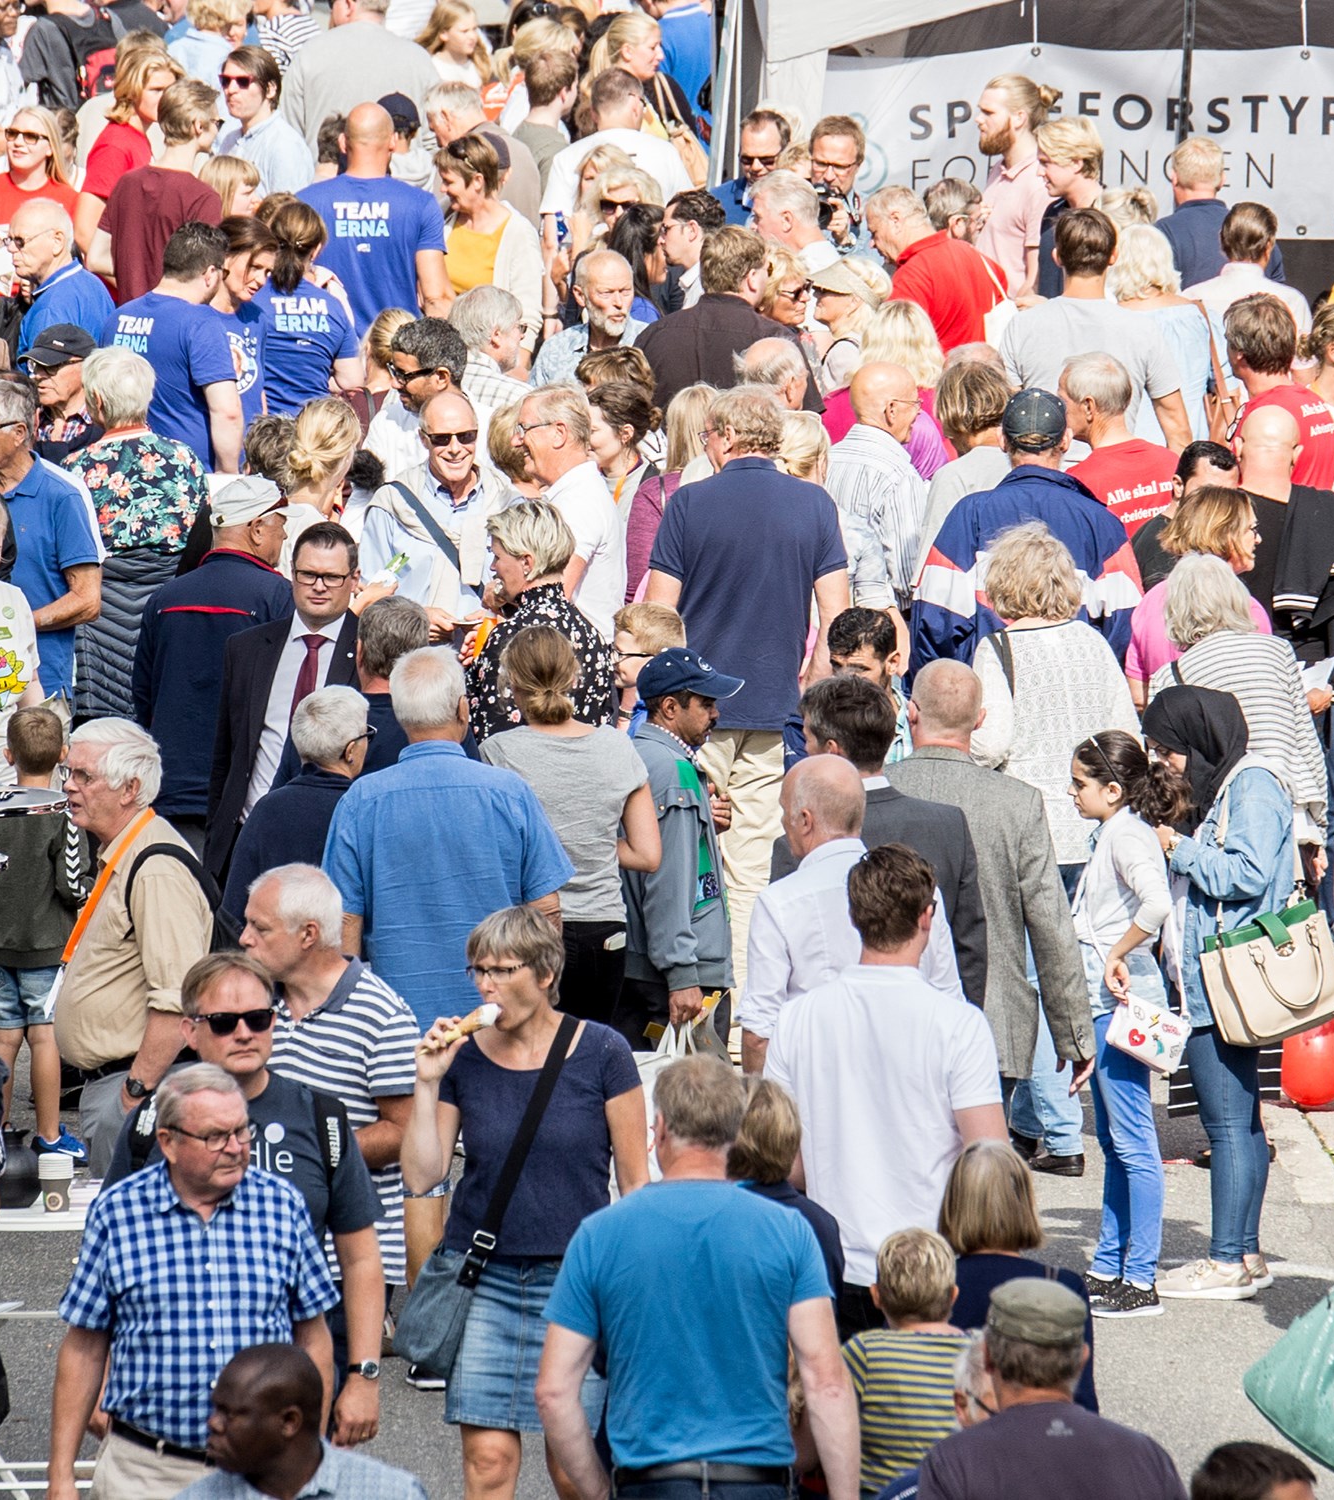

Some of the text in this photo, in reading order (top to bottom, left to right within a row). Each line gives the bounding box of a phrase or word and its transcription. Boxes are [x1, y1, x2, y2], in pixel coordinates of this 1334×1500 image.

[333, 202, 389, 219] TEAM
[335, 220, 389, 237] ERNA
[270, 297, 328, 315] TEAM
[117, 315, 154, 335] TEAM
[275, 315, 330, 333] ERNA
[1107, 485, 1132, 506] Alle
[1133, 480, 1159, 499] skal
